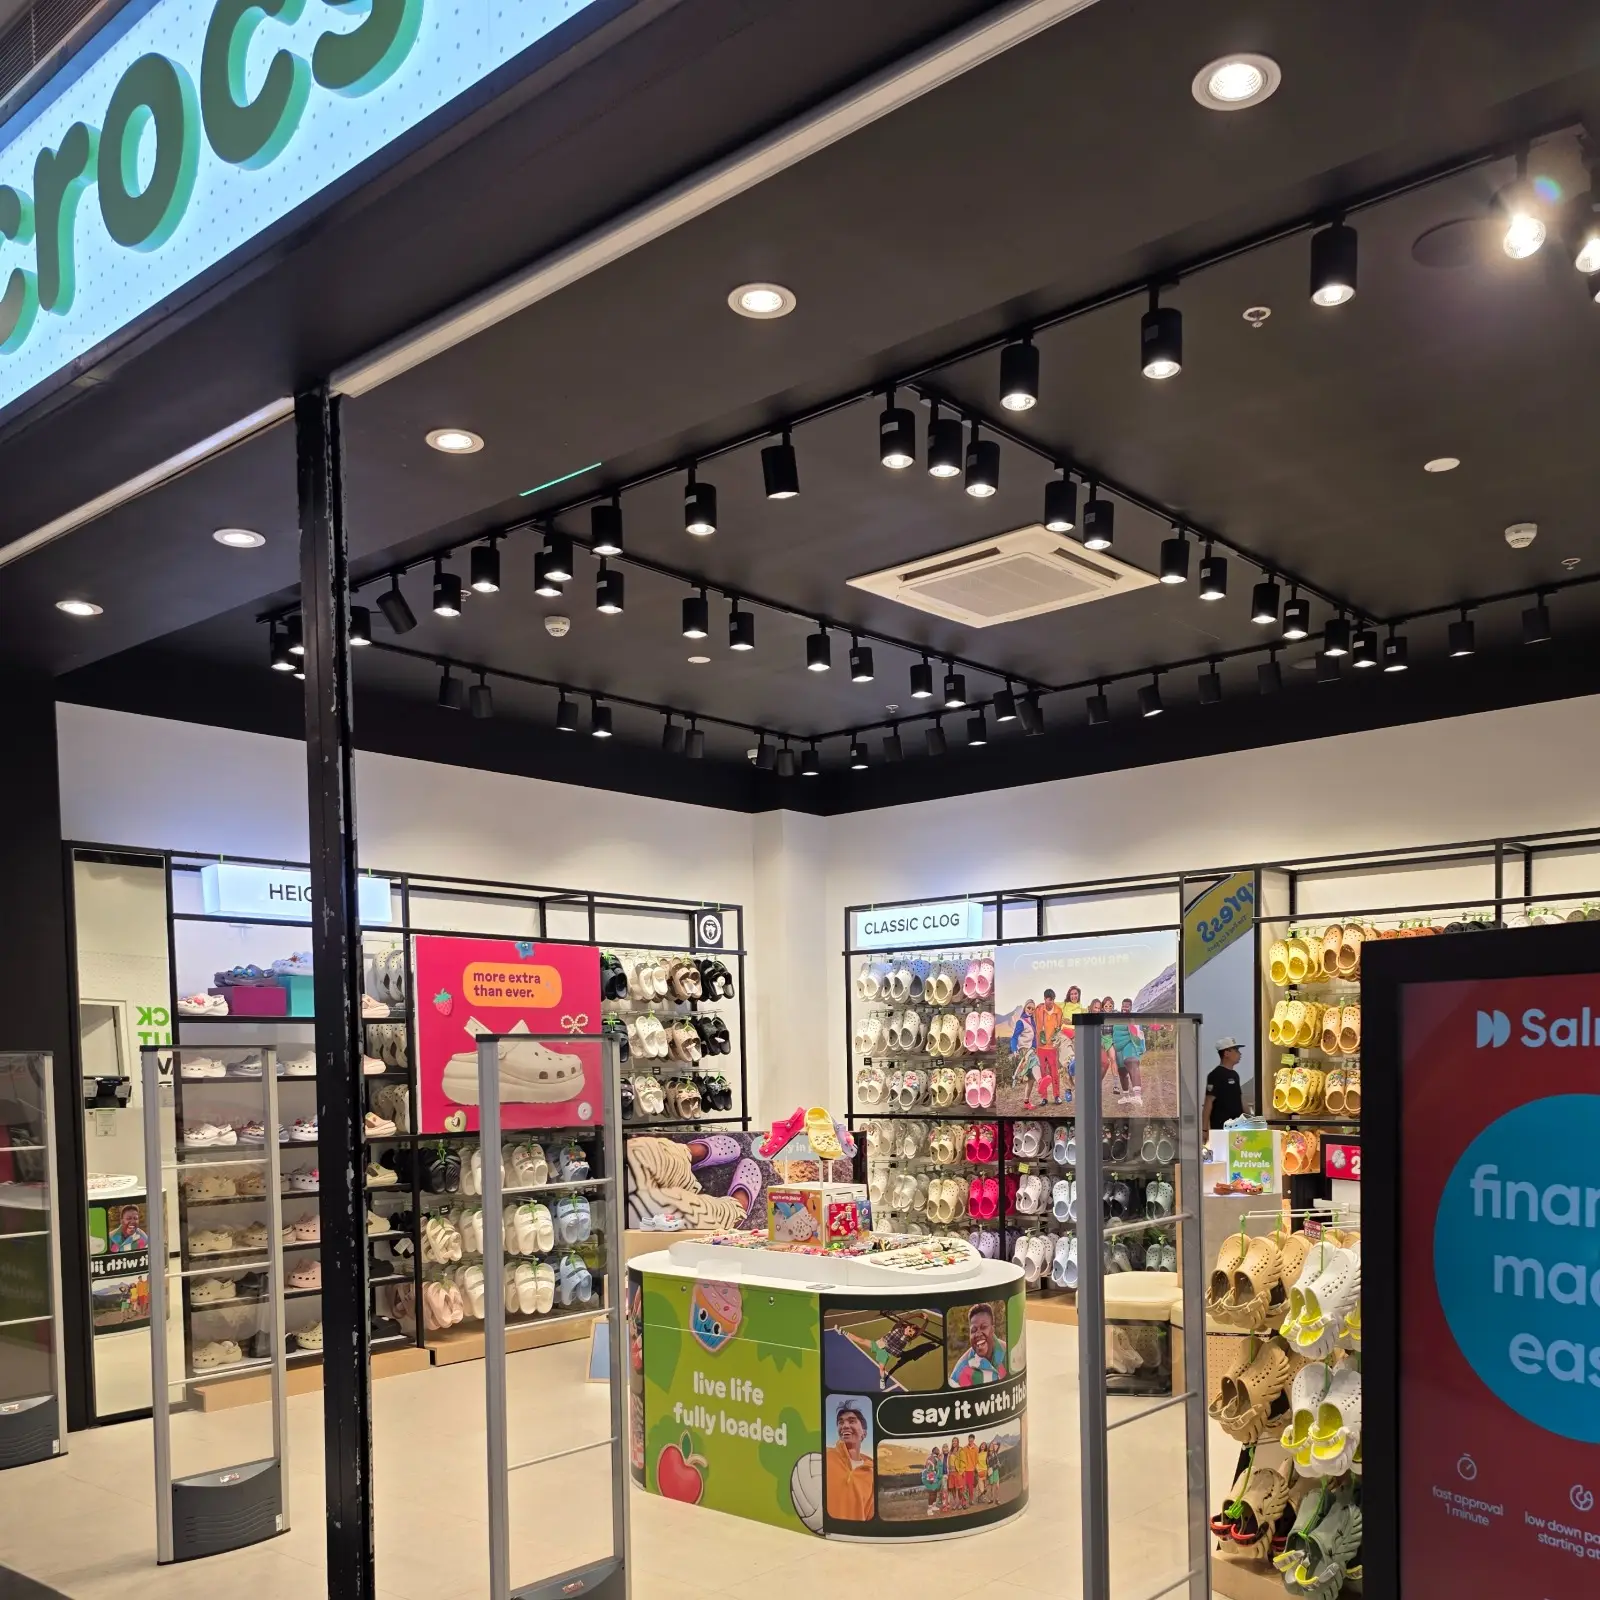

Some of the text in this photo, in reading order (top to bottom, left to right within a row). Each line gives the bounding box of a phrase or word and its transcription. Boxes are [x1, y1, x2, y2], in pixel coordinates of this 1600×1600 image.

[269, 883, 312, 903] HEI
[864, 913, 960, 935] CLASSIC CLOG
[1031, 958, 1064, 970] come
[1083, 955, 1105, 967] you
[473, 972, 541, 984] more extra
[473, 984, 535, 998] than ever.
[1520, 1006, 1600, 1048] Sal
[1233, 1160, 1270, 1168] Arrivals
[1240, 1150, 1262, 1158] New
[1493, 1254, 1600, 1308] ma
[693, 1371, 764, 1406] live life
[912, 1406, 951, 1427] say
[954, 1400, 972, 1420] it
[974, 1390, 1011, 1417] with
[673, 1402, 788, 1447] fully loaded
[1432, 1485, 1504, 1516] fast approval
[1445, 1503, 1490, 1526] 1 minute
[1524, 1511, 1545, 1528] low
[1547, 1520, 1582, 1540] down
[1537, 1533, 1584, 1557] starting
